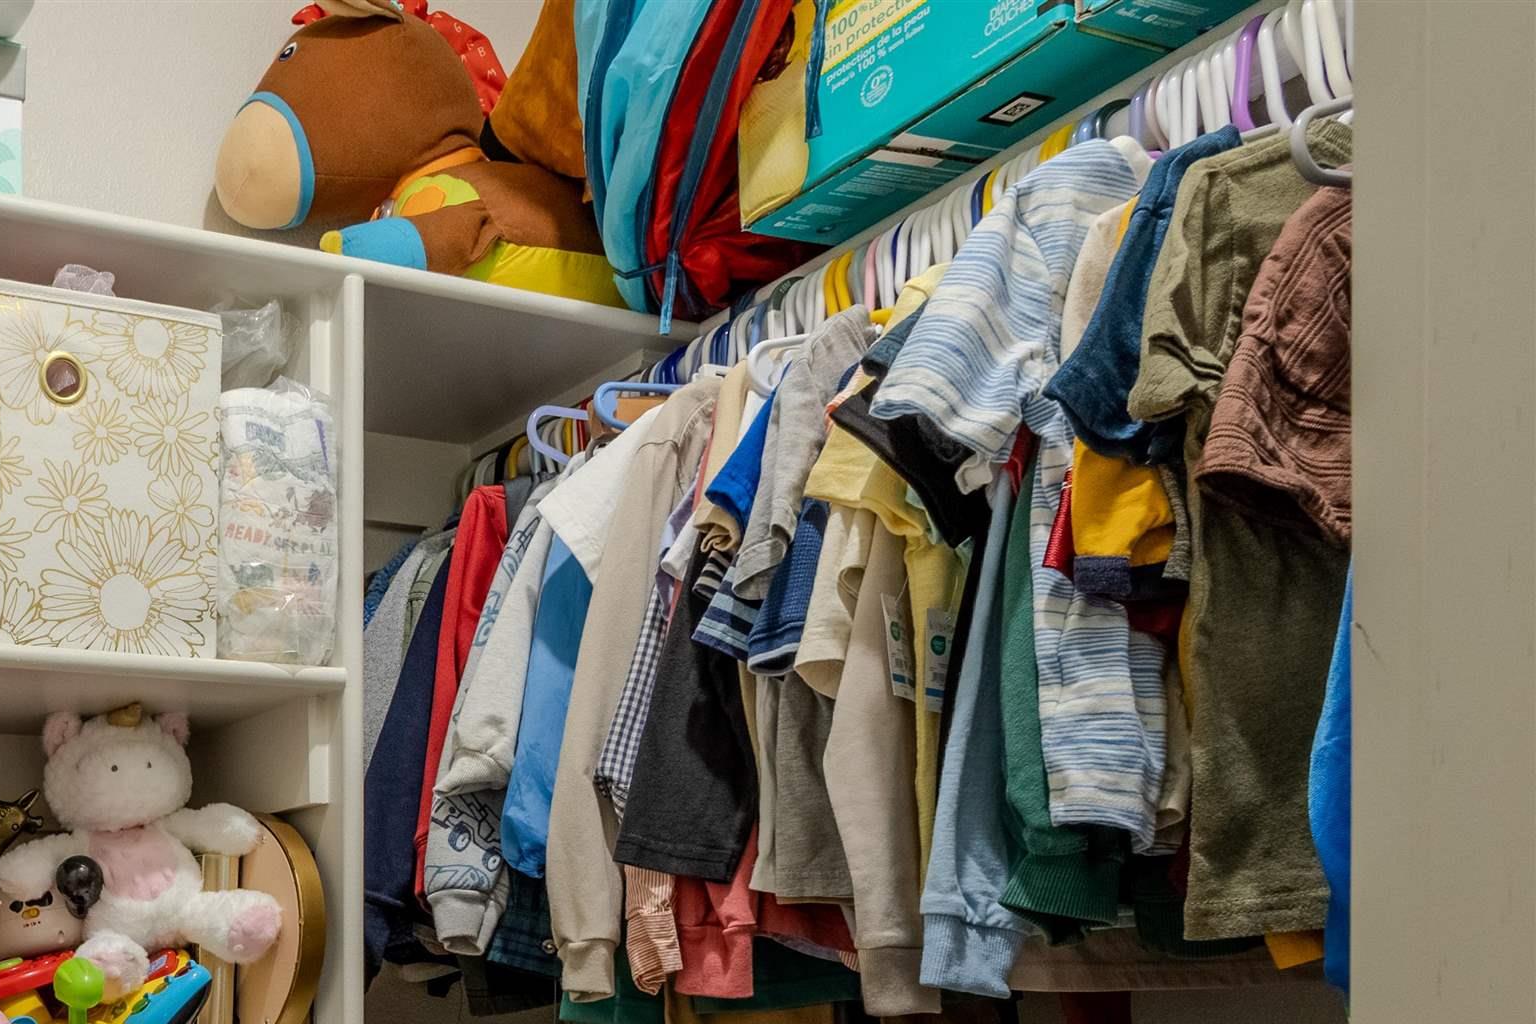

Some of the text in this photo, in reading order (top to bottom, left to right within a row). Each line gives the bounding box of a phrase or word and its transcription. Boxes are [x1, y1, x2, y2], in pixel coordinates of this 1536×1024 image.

[984, 0, 1034, 36] COUCHES
[826, 6, 931, 86] protection de la peau
[858, 54, 876, 72] 100
